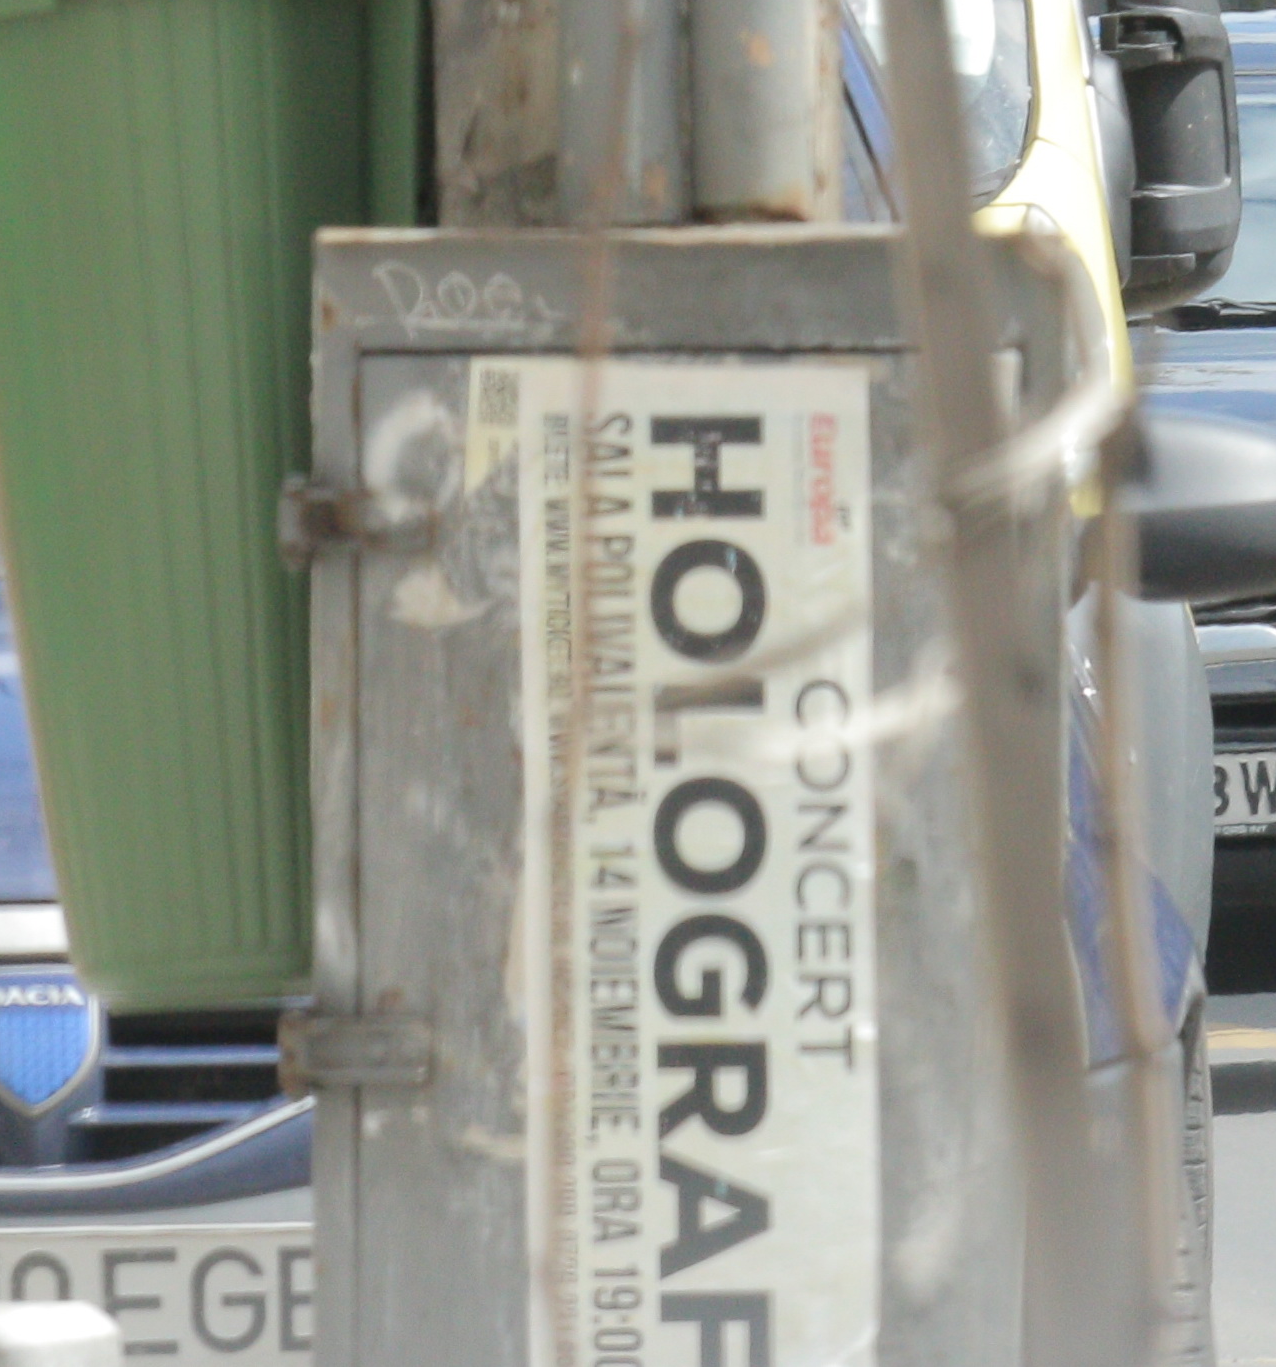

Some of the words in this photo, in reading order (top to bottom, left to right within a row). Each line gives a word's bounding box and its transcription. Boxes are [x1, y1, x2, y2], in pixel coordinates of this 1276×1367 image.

[589, 844, 639, 888] 14
[793, 678, 855, 1073] CONCERT
[590, 1158, 644, 1244] ORA
